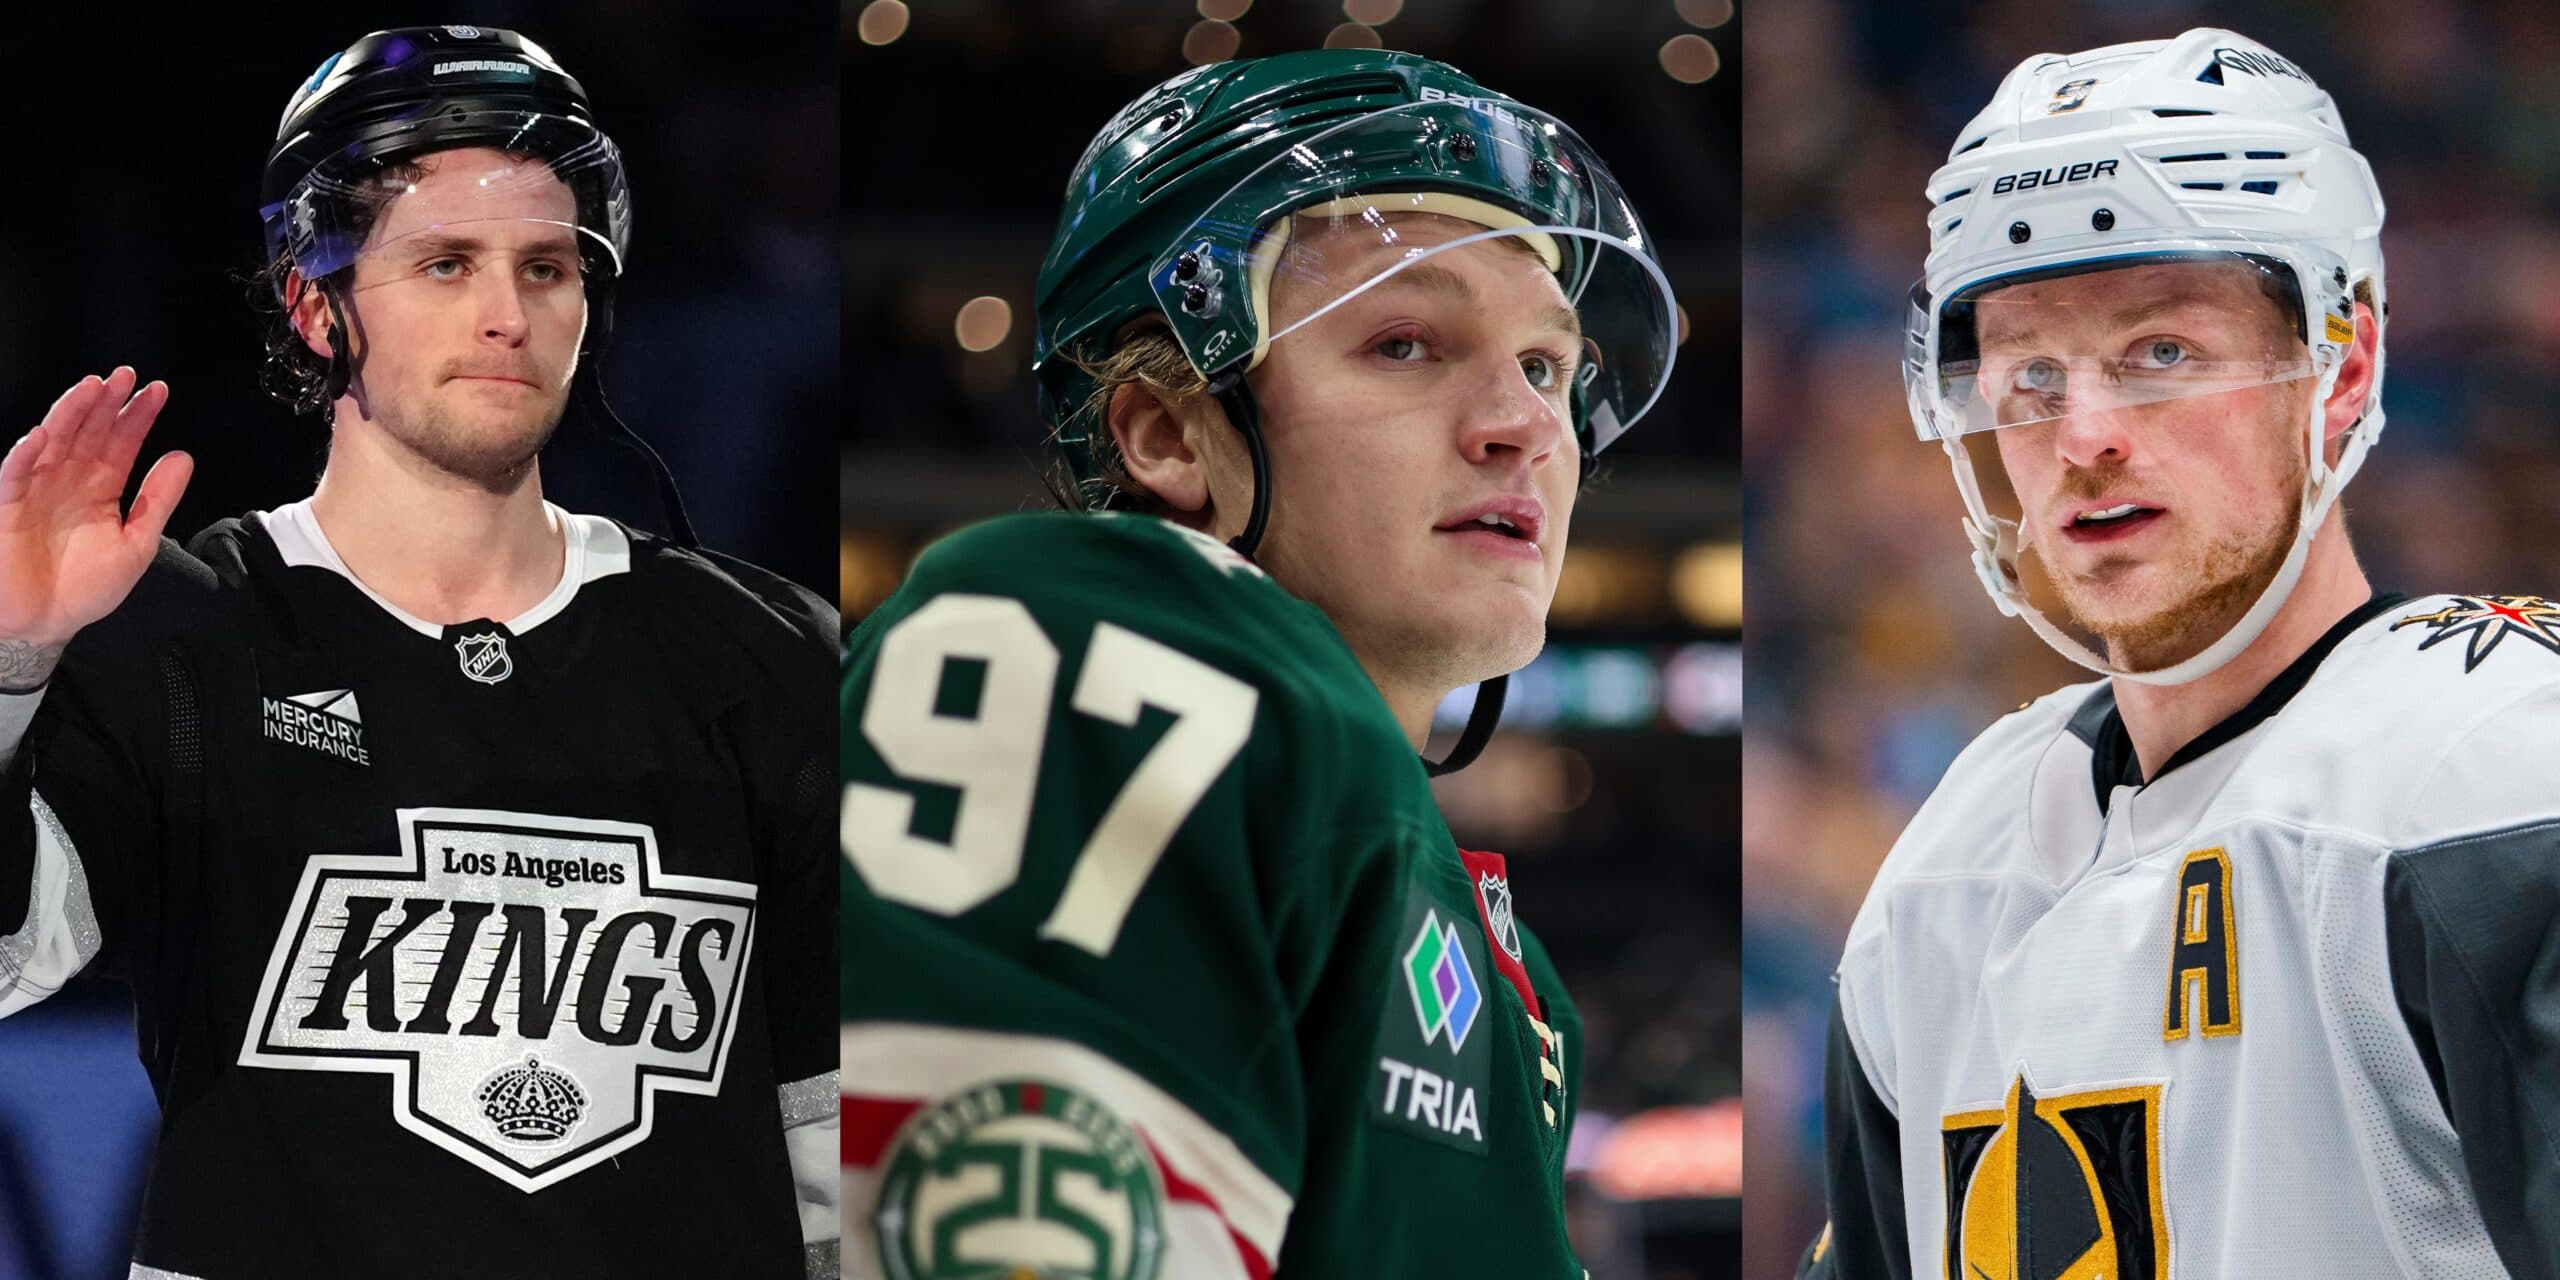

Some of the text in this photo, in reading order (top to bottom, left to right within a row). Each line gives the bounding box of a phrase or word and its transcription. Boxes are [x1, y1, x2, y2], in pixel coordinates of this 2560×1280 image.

[433, 60, 530, 76] WARRIOR
[2048, 79, 2099, 115] 9
[1202, 331, 1237, 370] OAKLEY
[472, 646, 499, 674] NHL
[263, 697, 362, 746] MERCURY
[263, 718, 371, 766] INSURANCE
[840, 592, 1260, 959] 97
[441, 847, 625, 888] Los Angeles
[2163, 847, 2241, 1041] A
[297, 896, 735, 1053] KINGS
[1379, 1056, 1483, 1142] TRIA
